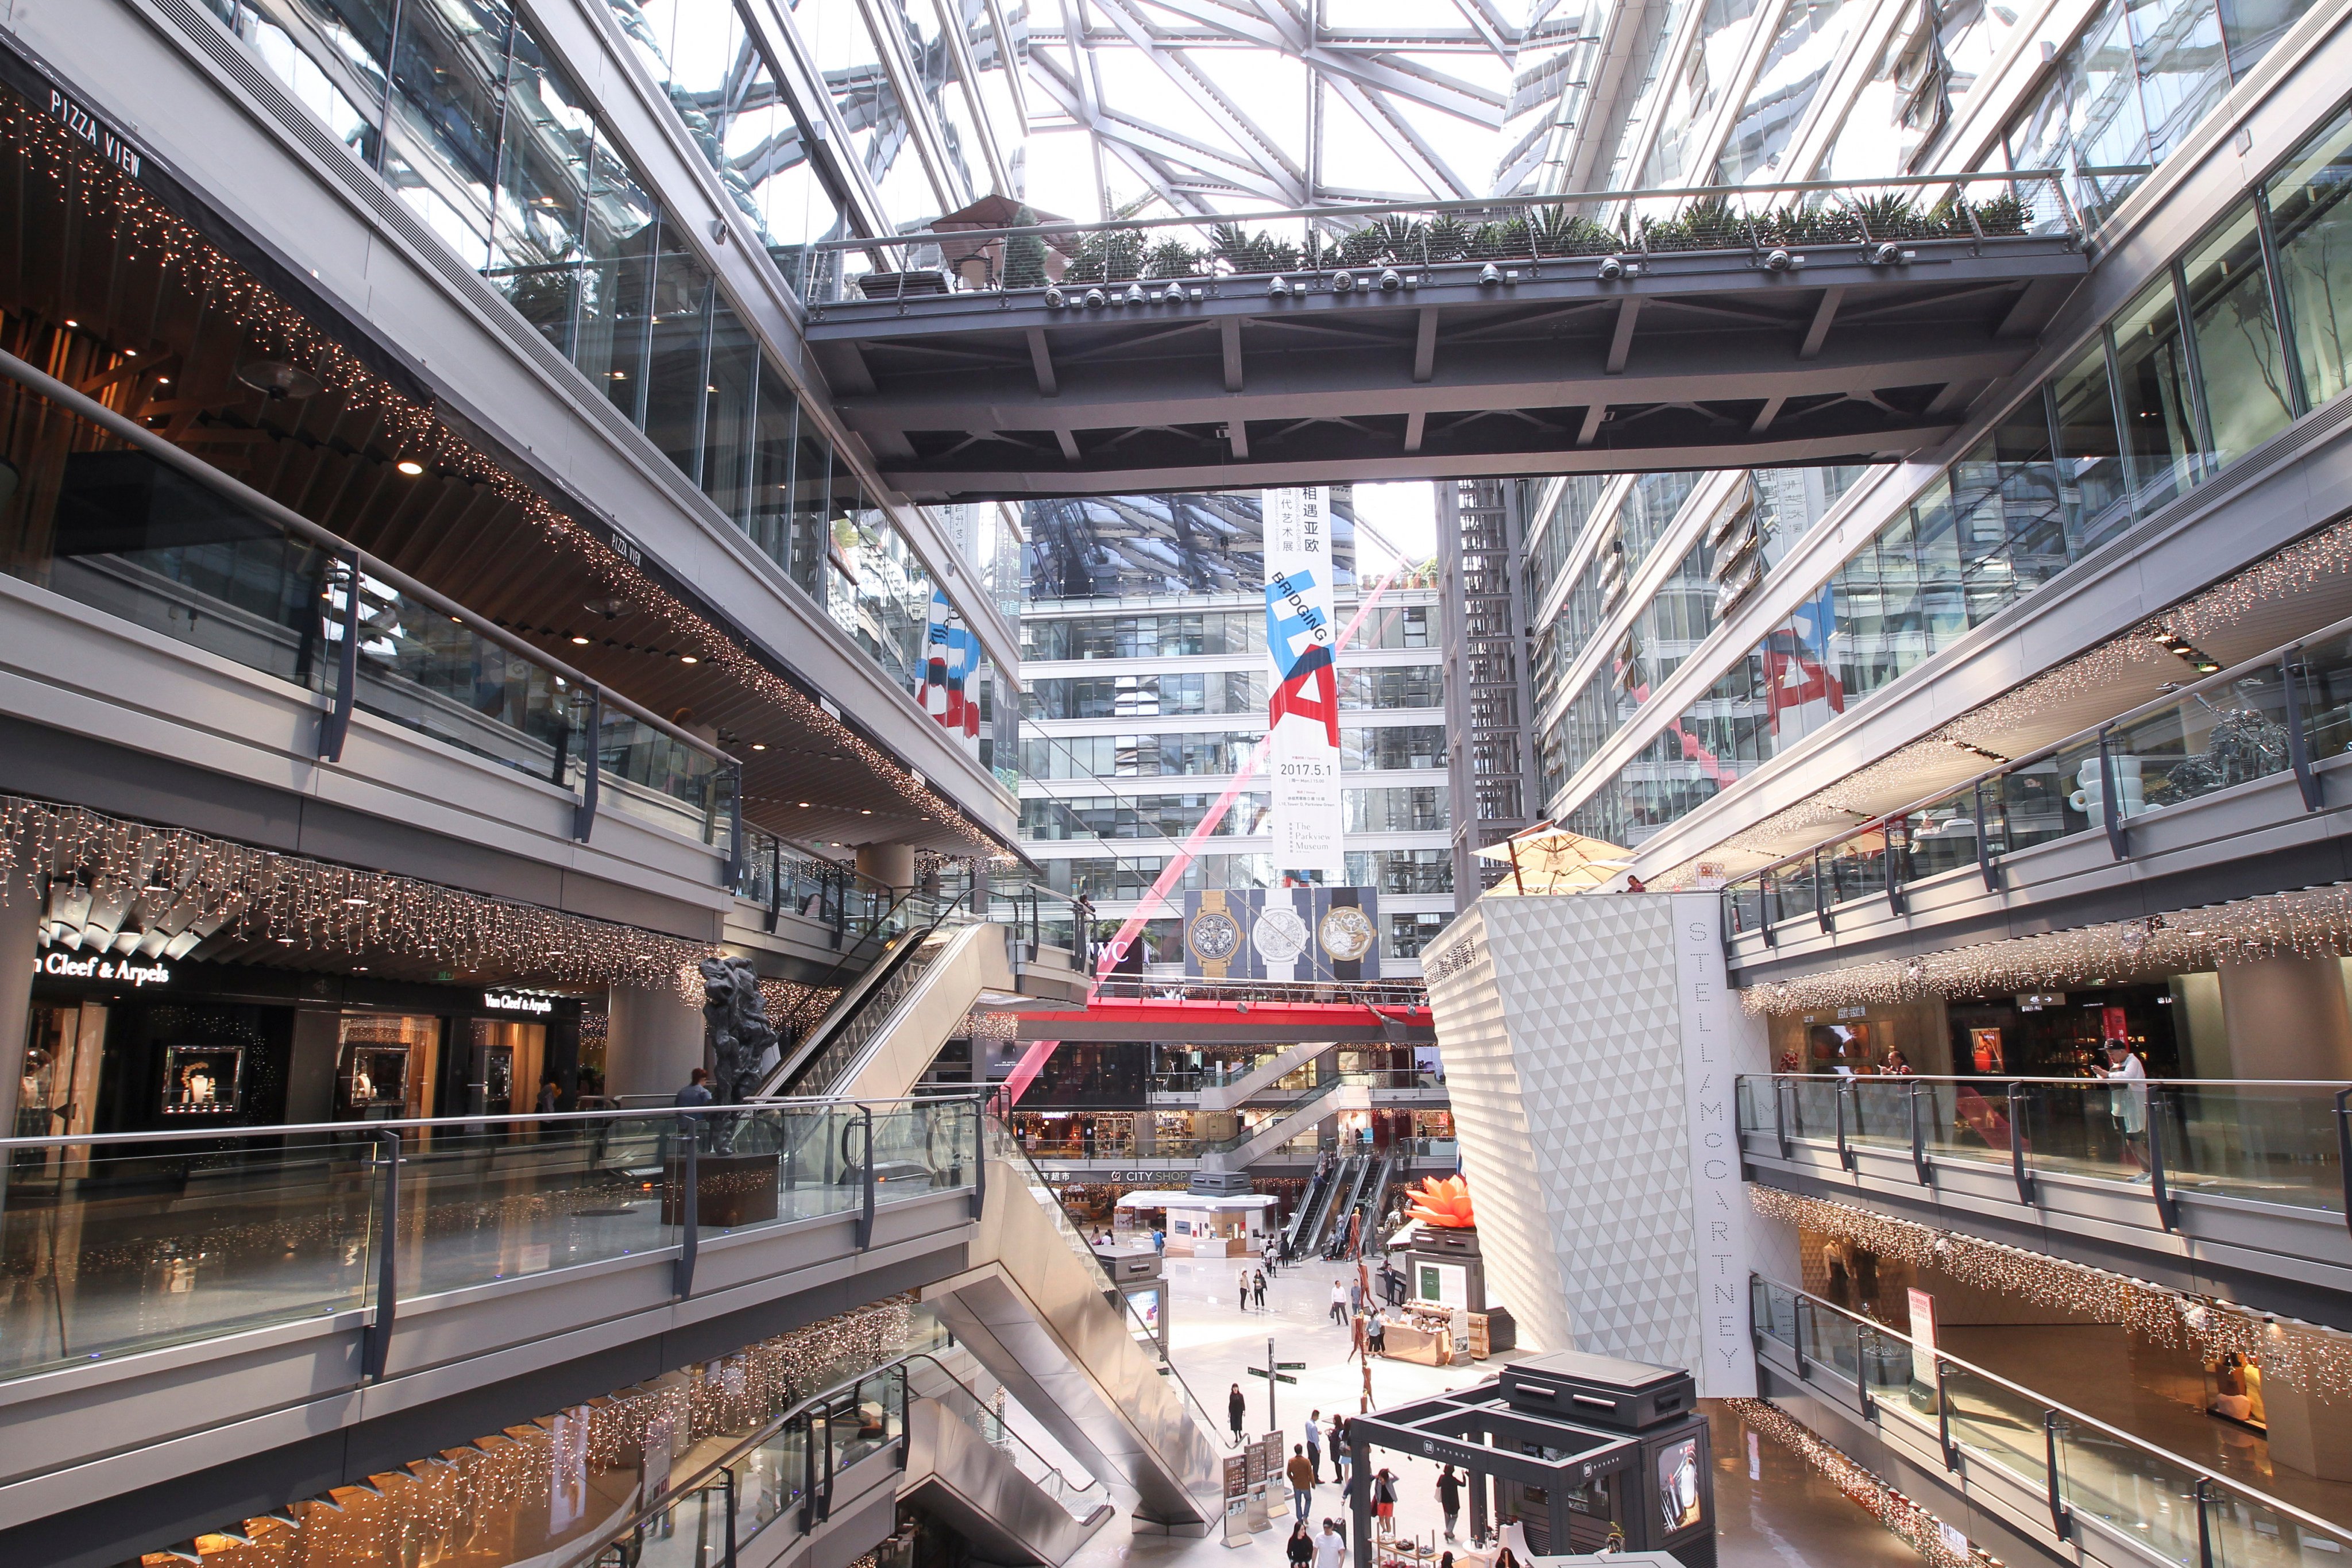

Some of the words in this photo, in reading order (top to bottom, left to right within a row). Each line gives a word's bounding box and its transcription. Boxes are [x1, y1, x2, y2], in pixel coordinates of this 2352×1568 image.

[50, 89, 97, 145] PIZZA
[105, 132, 141, 178] VIEW
[1303, 486, 1319, 553] 相遇亚欧
[612, 533, 627, 557] PIZZA
[629, 546, 641, 567] VIEW
[1271, 571, 1327, 642] BRIDGING
[1280, 764, 1331, 776] 2017.5.1
[1296, 822, 1311, 831] The
[1296, 832, 1331, 840] Parkview
[1296, 842, 1328, 850] Museum
[1090, 941, 1129, 962] WC
[45, 952, 99, 977] Cleef
[99, 962, 114, 979] &
[115, 960, 169, 987] Arpels
[484, 993, 500, 1009] Van
[501, 995, 523, 1010] Cleef
[522, 999, 529, 1010] &
[529, 998, 552, 1015] Arpels
[1031, 1172, 1070, 1181] 城市超市
[1126, 1171, 1153, 1181] CITY
[1156, 1171, 1188, 1181] SHOP
